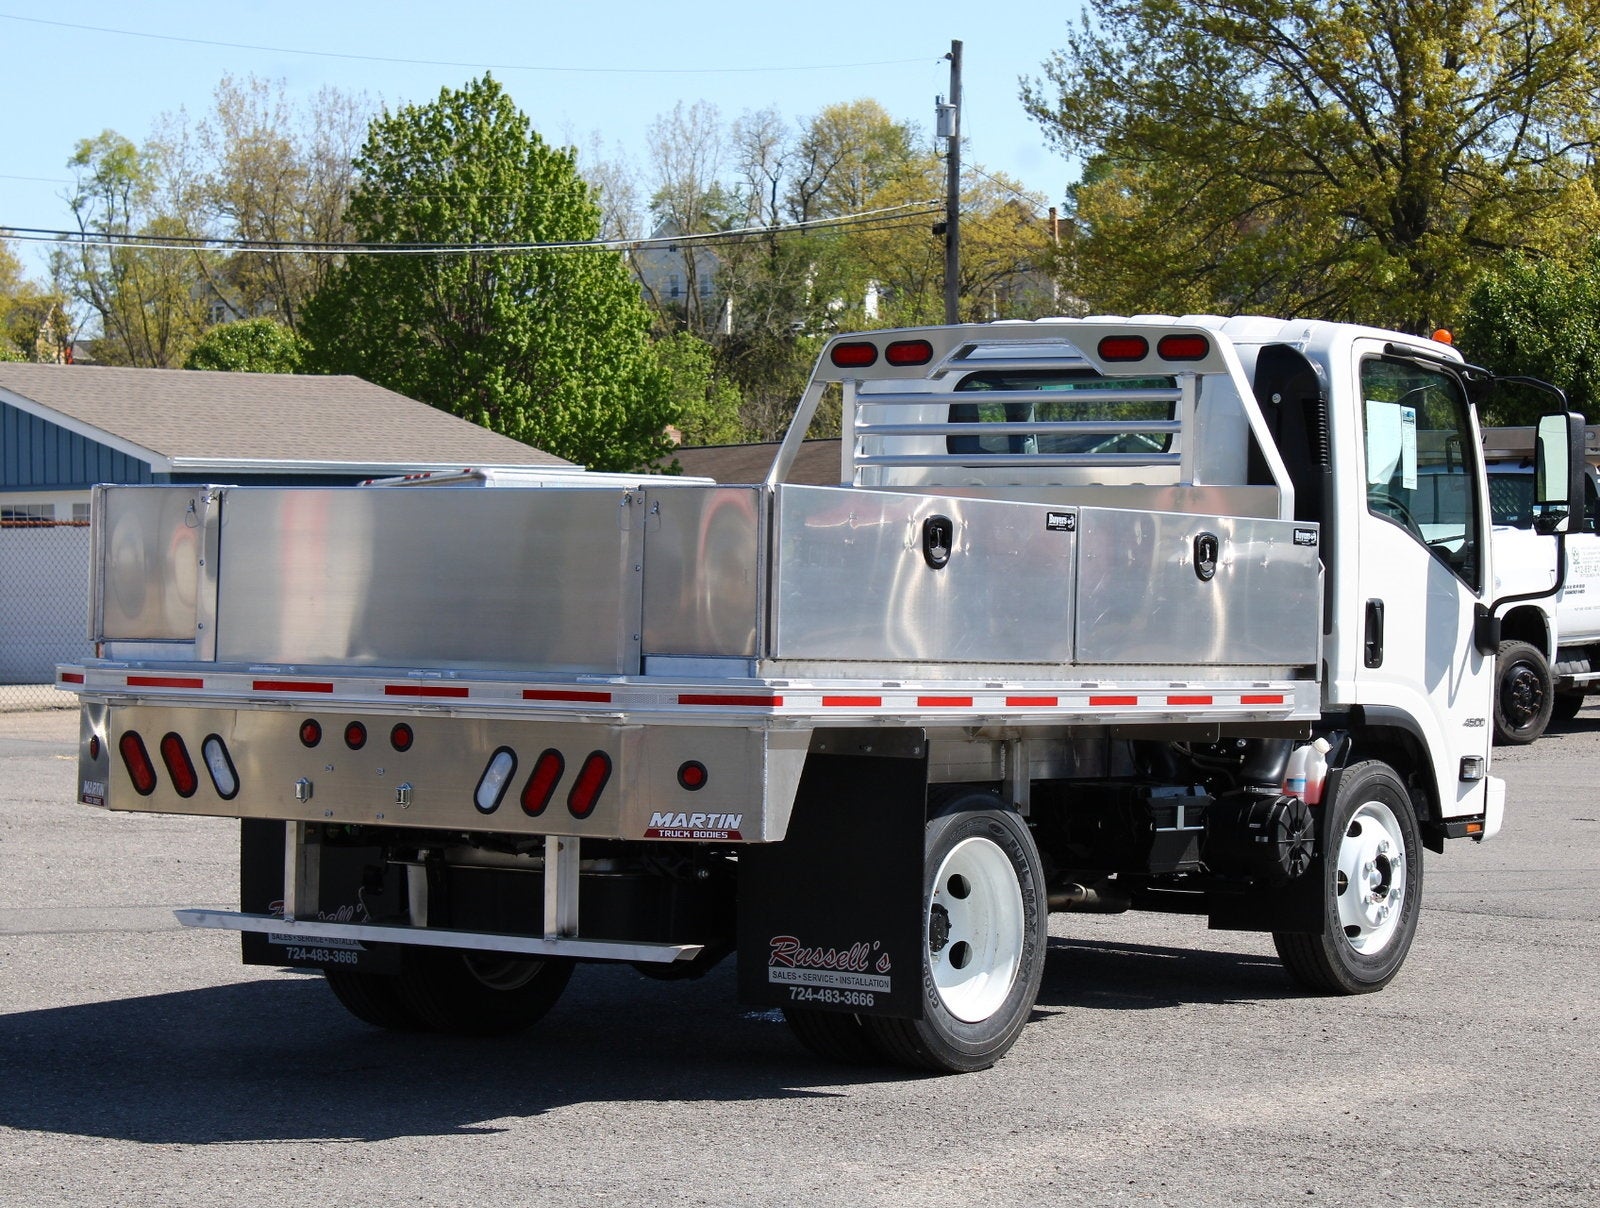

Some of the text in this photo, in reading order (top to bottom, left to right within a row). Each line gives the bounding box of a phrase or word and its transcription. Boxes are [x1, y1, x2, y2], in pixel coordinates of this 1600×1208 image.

[649, 812, 743, 829] MARTIN
[659, 829, 729, 839] TRUCK BODIES
[286, 947, 358, 964] 724-483-3666
[768, 935, 891, 973] Russell's
[772, 970, 889, 988] SALES SERVICE INSTALLATION
[789, 986, 874, 1007] 724-483-3666
